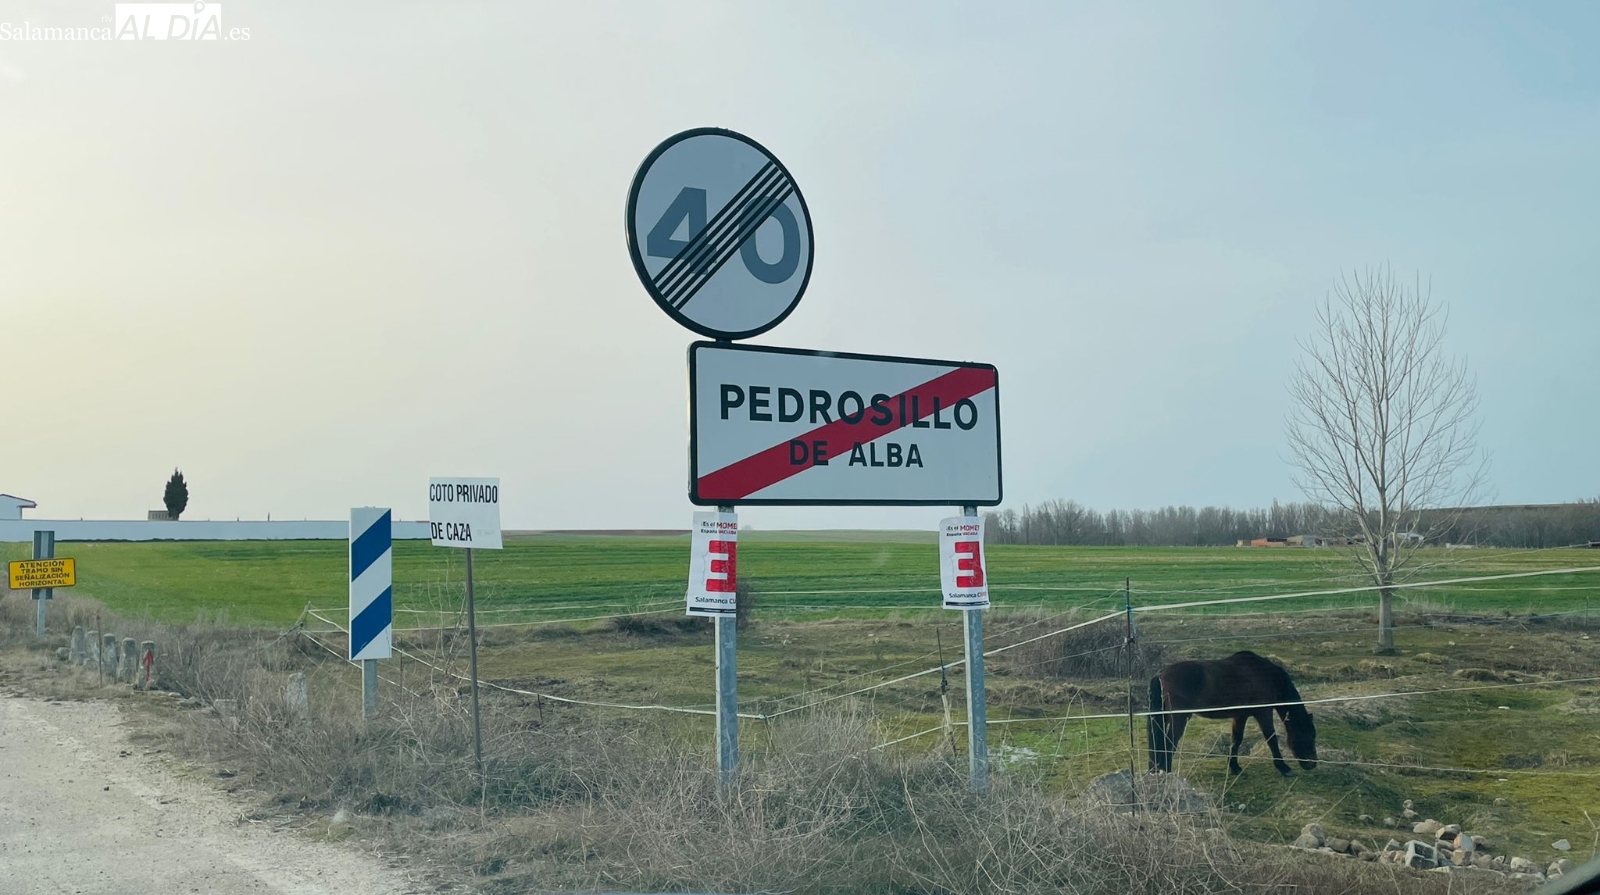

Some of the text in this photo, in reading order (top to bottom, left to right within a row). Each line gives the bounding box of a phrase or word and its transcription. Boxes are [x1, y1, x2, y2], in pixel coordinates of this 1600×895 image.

[646, 186, 801, 285] 40
[719, 384, 979, 431] PEDROSILLO
[789, 439, 924, 468] DE ALBA
[429, 483, 498, 504] COTO PRIVADO
[430, 522, 444, 540] DE
[446, 522, 473, 542] CAZA
[15, 573, 70, 581] SEÑALIZACIÓN
[695, 596, 728, 604] Salamanca
